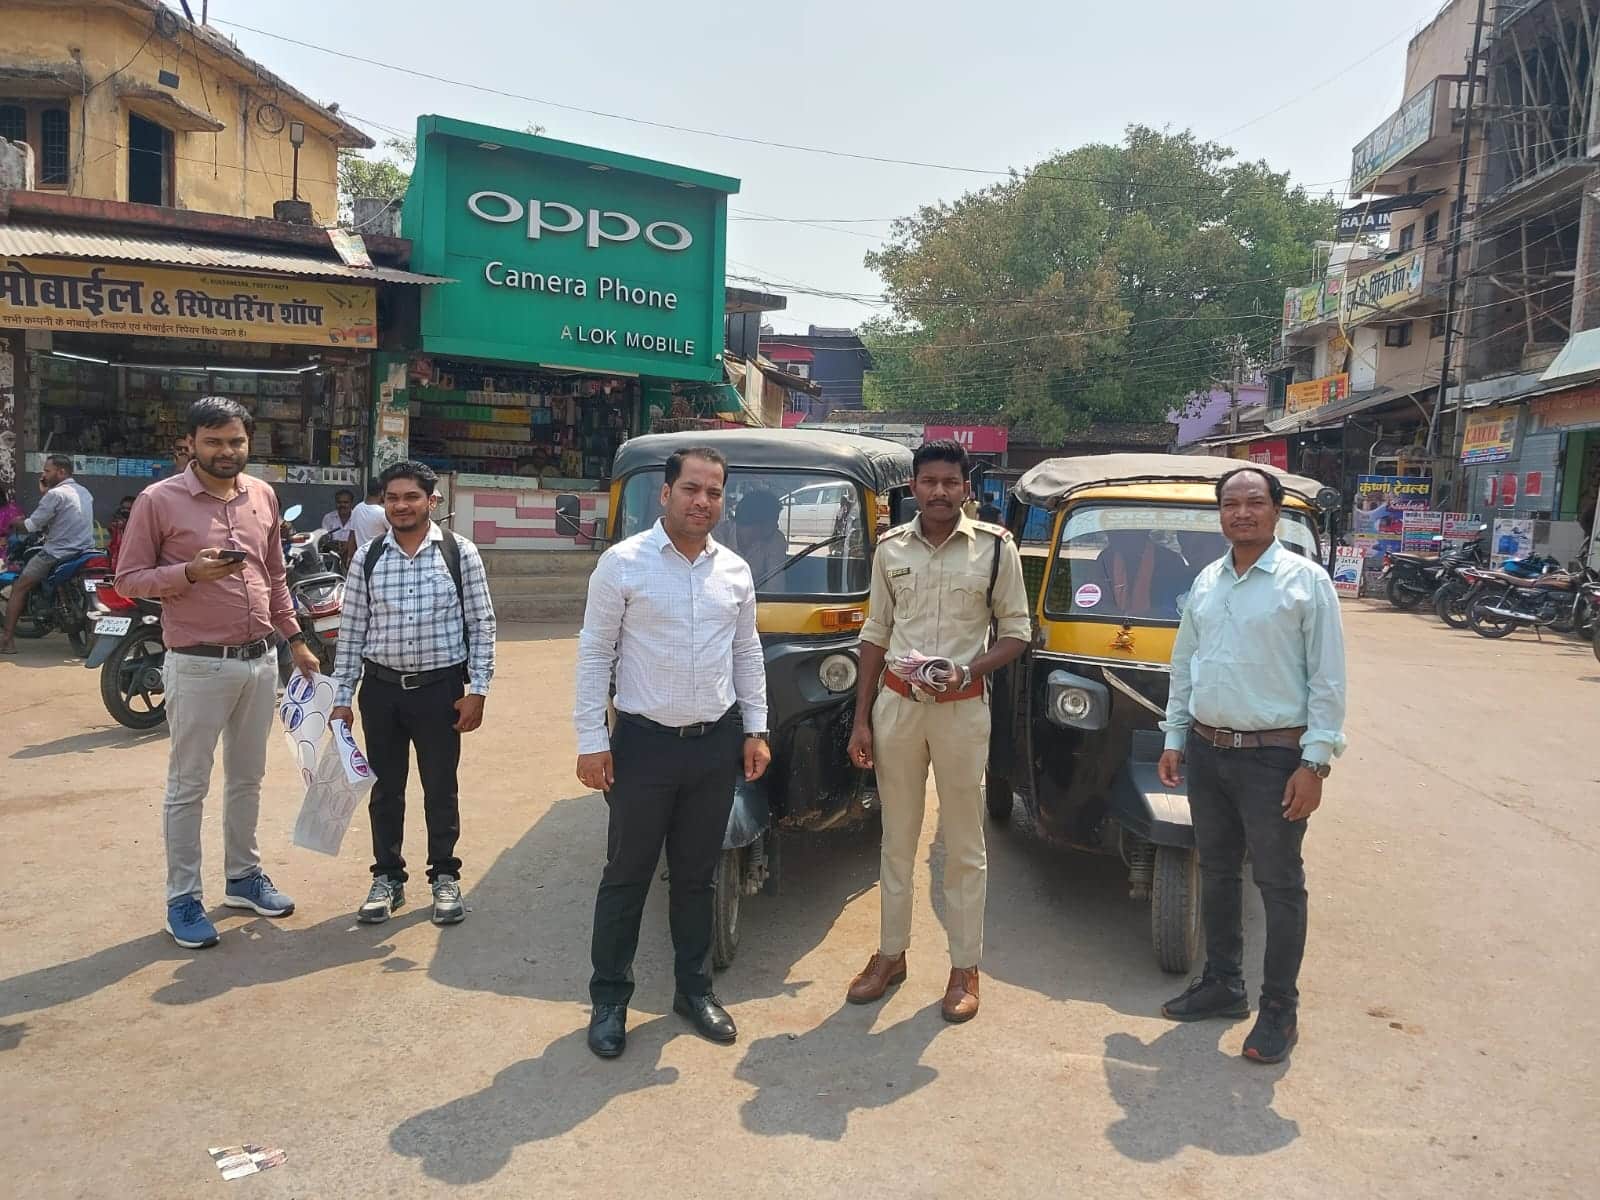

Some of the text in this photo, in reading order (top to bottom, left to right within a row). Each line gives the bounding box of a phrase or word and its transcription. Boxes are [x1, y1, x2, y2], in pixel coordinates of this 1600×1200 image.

[1341, 215, 1375, 229] RAJA
[0, 261, 324, 326] मोबाईल & रिपेयरिंग शॉप
[485, 261, 678, 310] Camera Phone
[66, 318, 98, 329] मोबाईल
[143, 322, 174, 334] मोबाईल
[626, 332, 695, 356] MOBILE
[1360, 482, 1390, 497] कृष्णा
